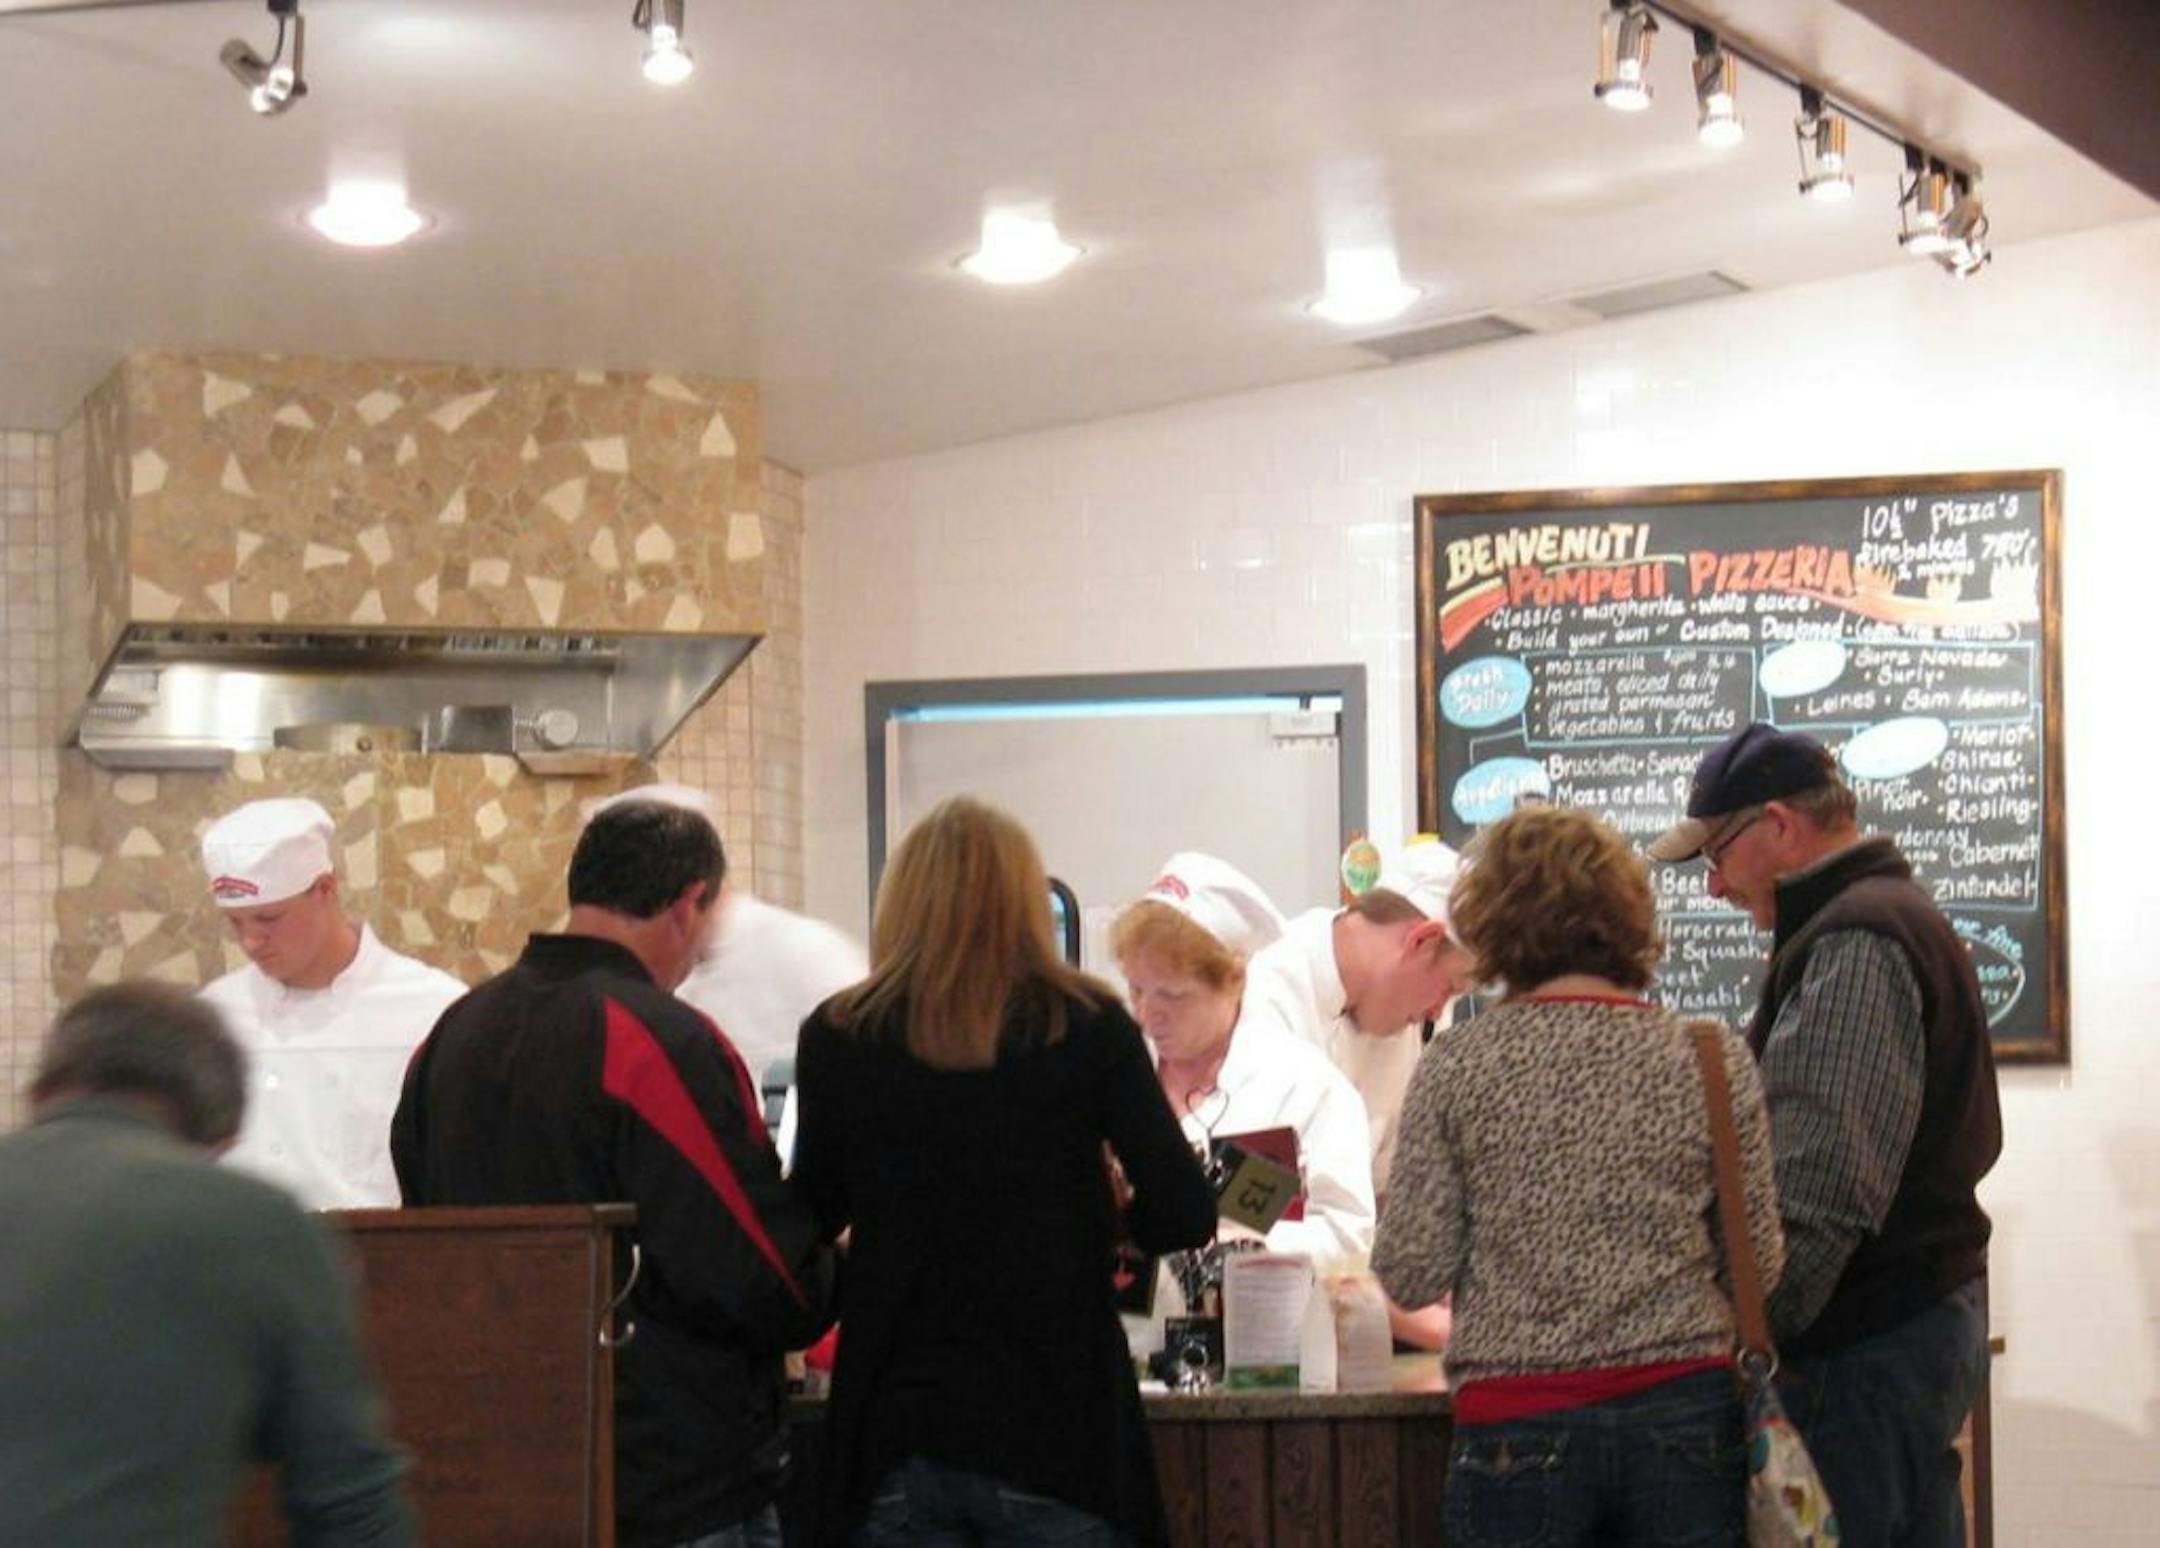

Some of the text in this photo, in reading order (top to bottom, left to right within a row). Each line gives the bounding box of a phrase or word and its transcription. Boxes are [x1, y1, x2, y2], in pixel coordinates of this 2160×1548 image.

[1445, 522, 1649, 592] BENVENUTI
[1688, 544, 1854, 598] PIZZERIA
[1507, 624, 1558, 650] Build
[1568, 631, 1607, 657] your
[1615, 621, 1649, 643] own
[1680, 617, 1750, 641] Custom
[1877, 664, 1935, 689] Surly
[1902, 686, 1950, 712] Sam
[1944, 767, 2025, 795] Chianti
[1945, 796, 2031, 825] Riesling
[1949, 834, 2039, 868] Cabernet
[1933, 868, 2031, 902] Zinfandel
[1661, 983, 1741, 1012] Wasabi
